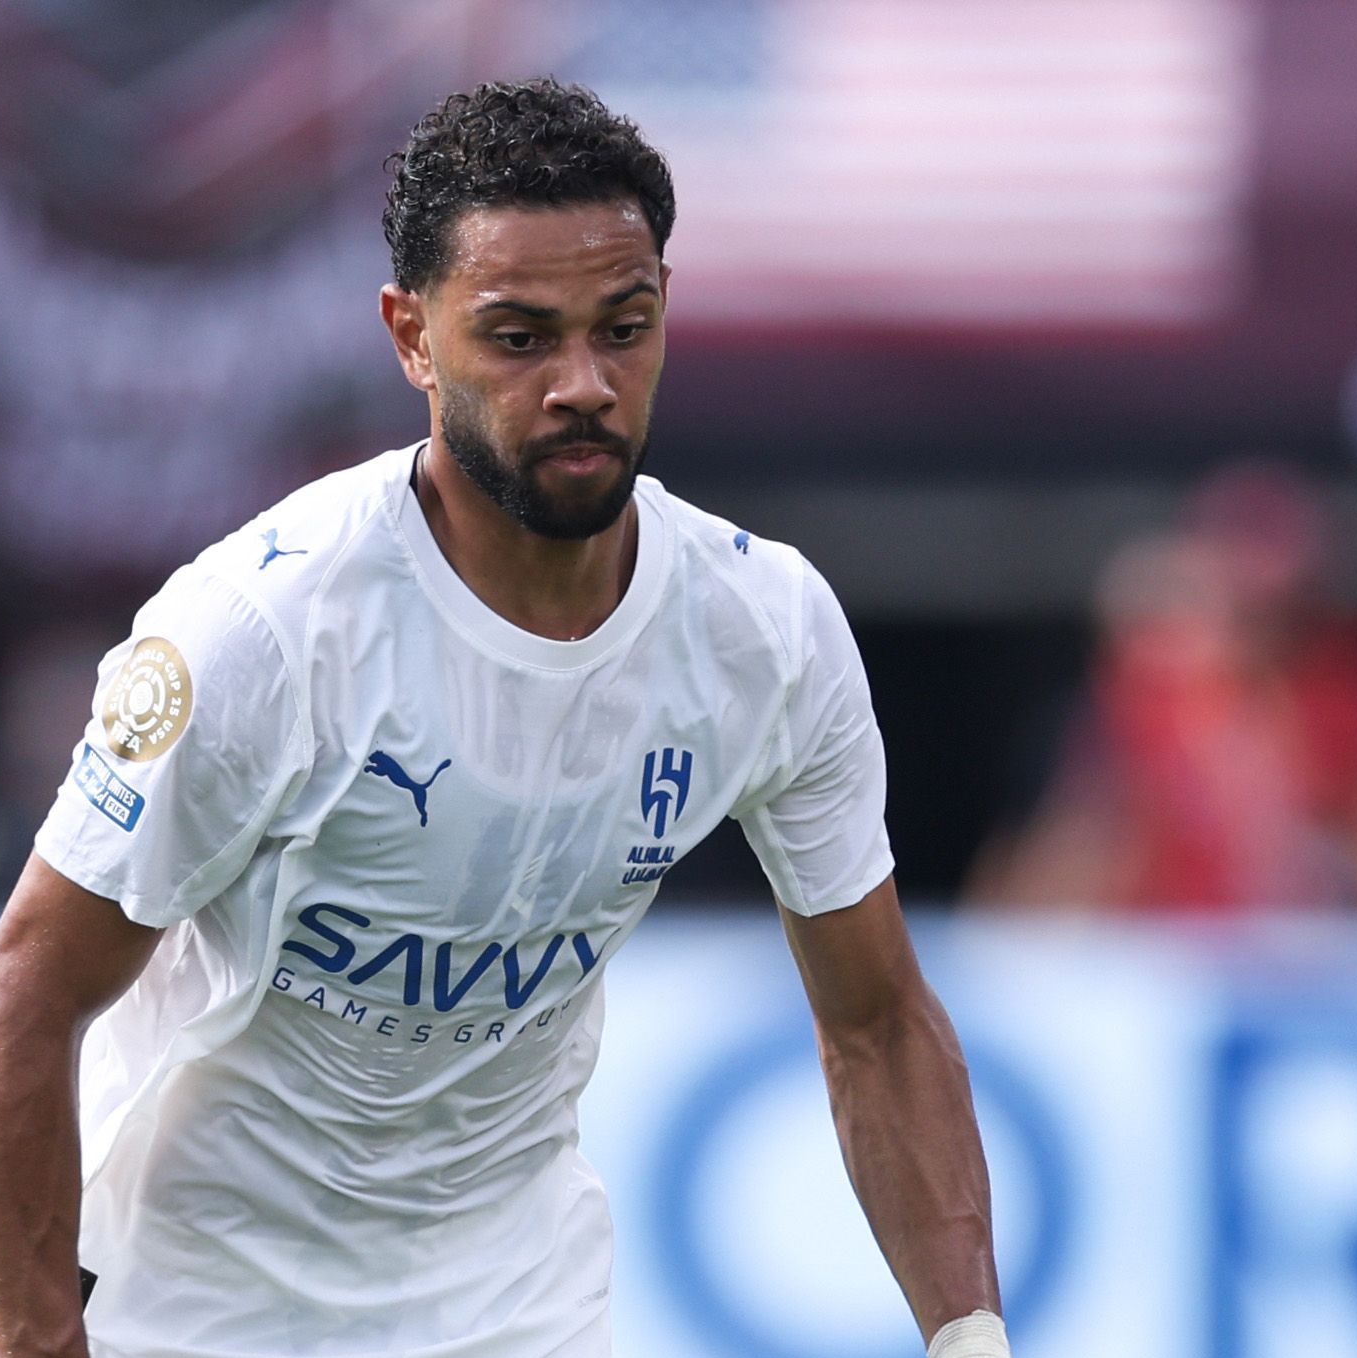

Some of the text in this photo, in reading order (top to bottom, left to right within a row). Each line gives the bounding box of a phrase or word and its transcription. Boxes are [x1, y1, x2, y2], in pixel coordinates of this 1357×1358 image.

[165, 661, 182, 692] CUP
[169, 697, 182, 717] 25
[111, 719, 141, 754] FIFA
[148, 719, 174, 745] USA
[107, 799, 127, 821] FIFA
[281, 902, 622, 1012] SAVVY
[271, 965, 434, 1043] GAMES
